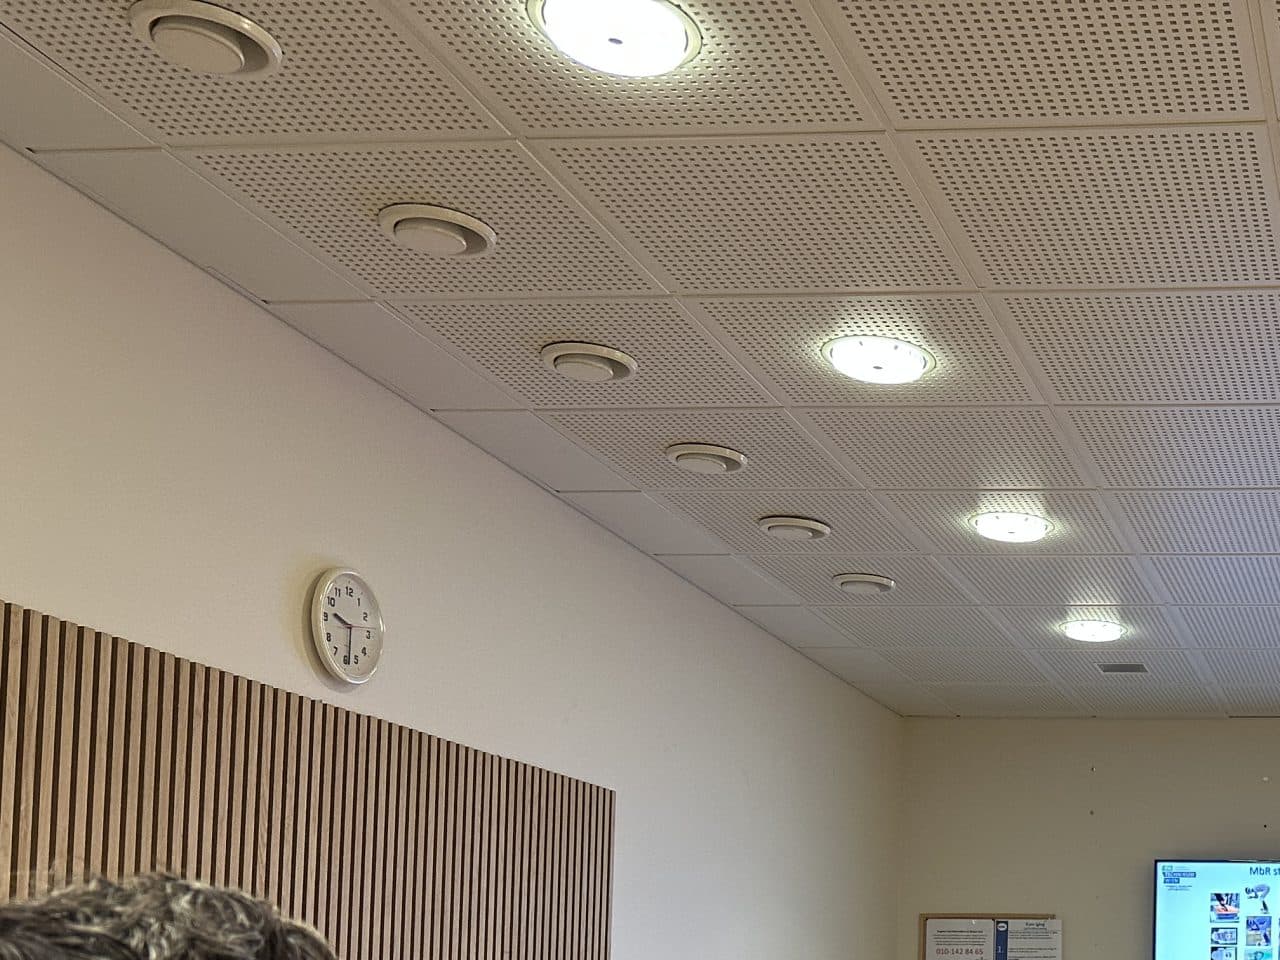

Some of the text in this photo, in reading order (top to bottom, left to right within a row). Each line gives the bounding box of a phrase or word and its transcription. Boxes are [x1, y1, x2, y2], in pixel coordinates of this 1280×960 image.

[334, 588, 341, 598] 11
[345, 586, 354, 597] 12
[327, 596, 336, 607] 10
[357, 598, 360, 607] 1
[323, 612, 328, 622] 9
[363, 612, 368, 622] 2
[326, 632, 332, 642] 8
[366, 630, 370, 640] 3
[334, 646, 338, 656] 7
[362, 646, 366, 656] 4
[343, 655, 348, 665] 6
[354, 655, 358, 664] 5
[1249, 866, 1271, 877] MbR
